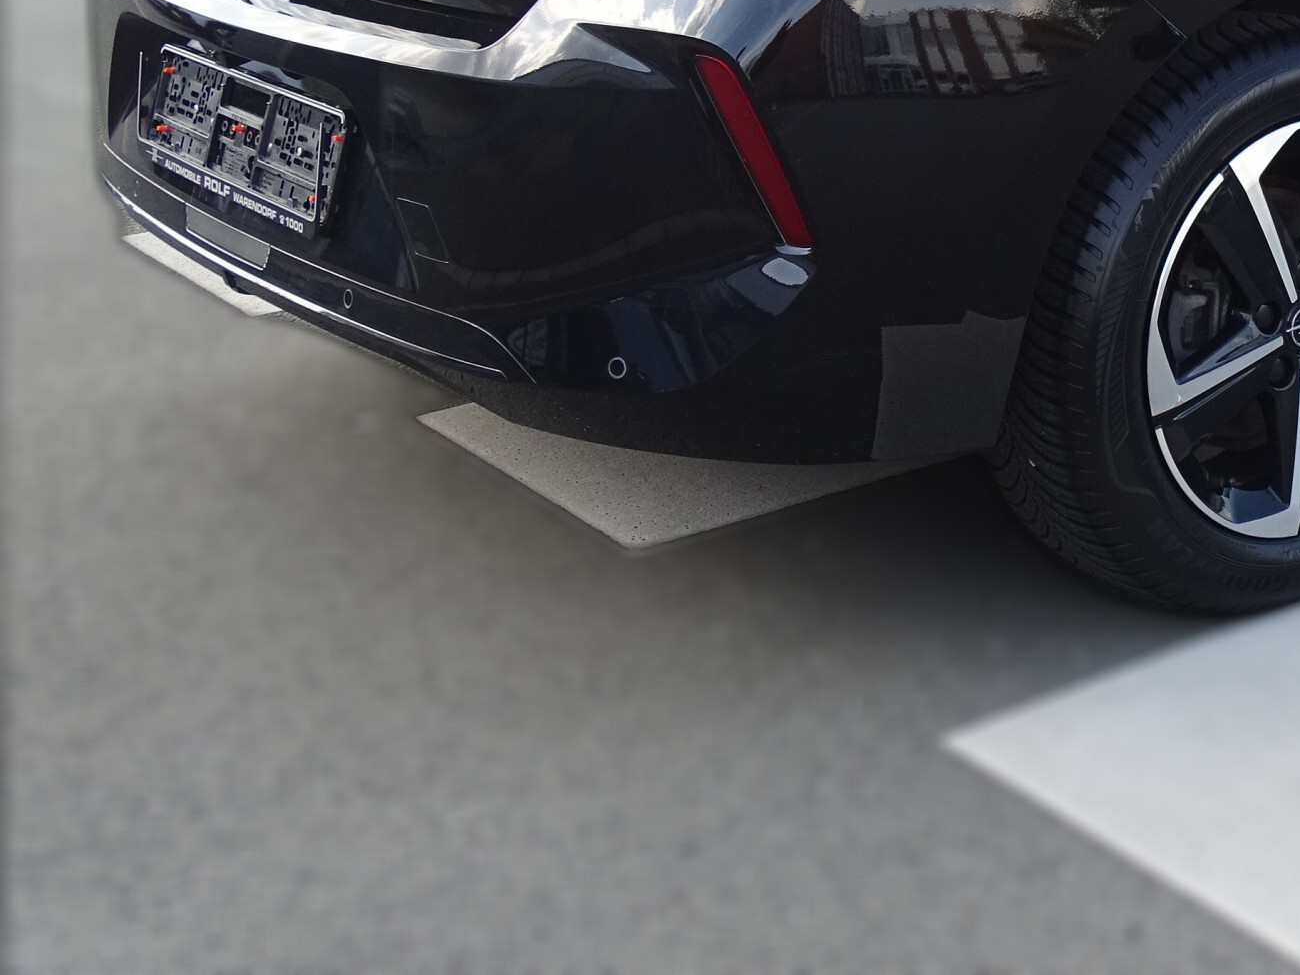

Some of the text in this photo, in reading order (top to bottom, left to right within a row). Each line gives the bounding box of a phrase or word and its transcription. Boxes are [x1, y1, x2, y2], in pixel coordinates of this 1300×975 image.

[164, 158, 202, 185] AUTOMOBILE
[203, 175, 231, 198] ROLF
[232, 190, 278, 221] WARENDORF
